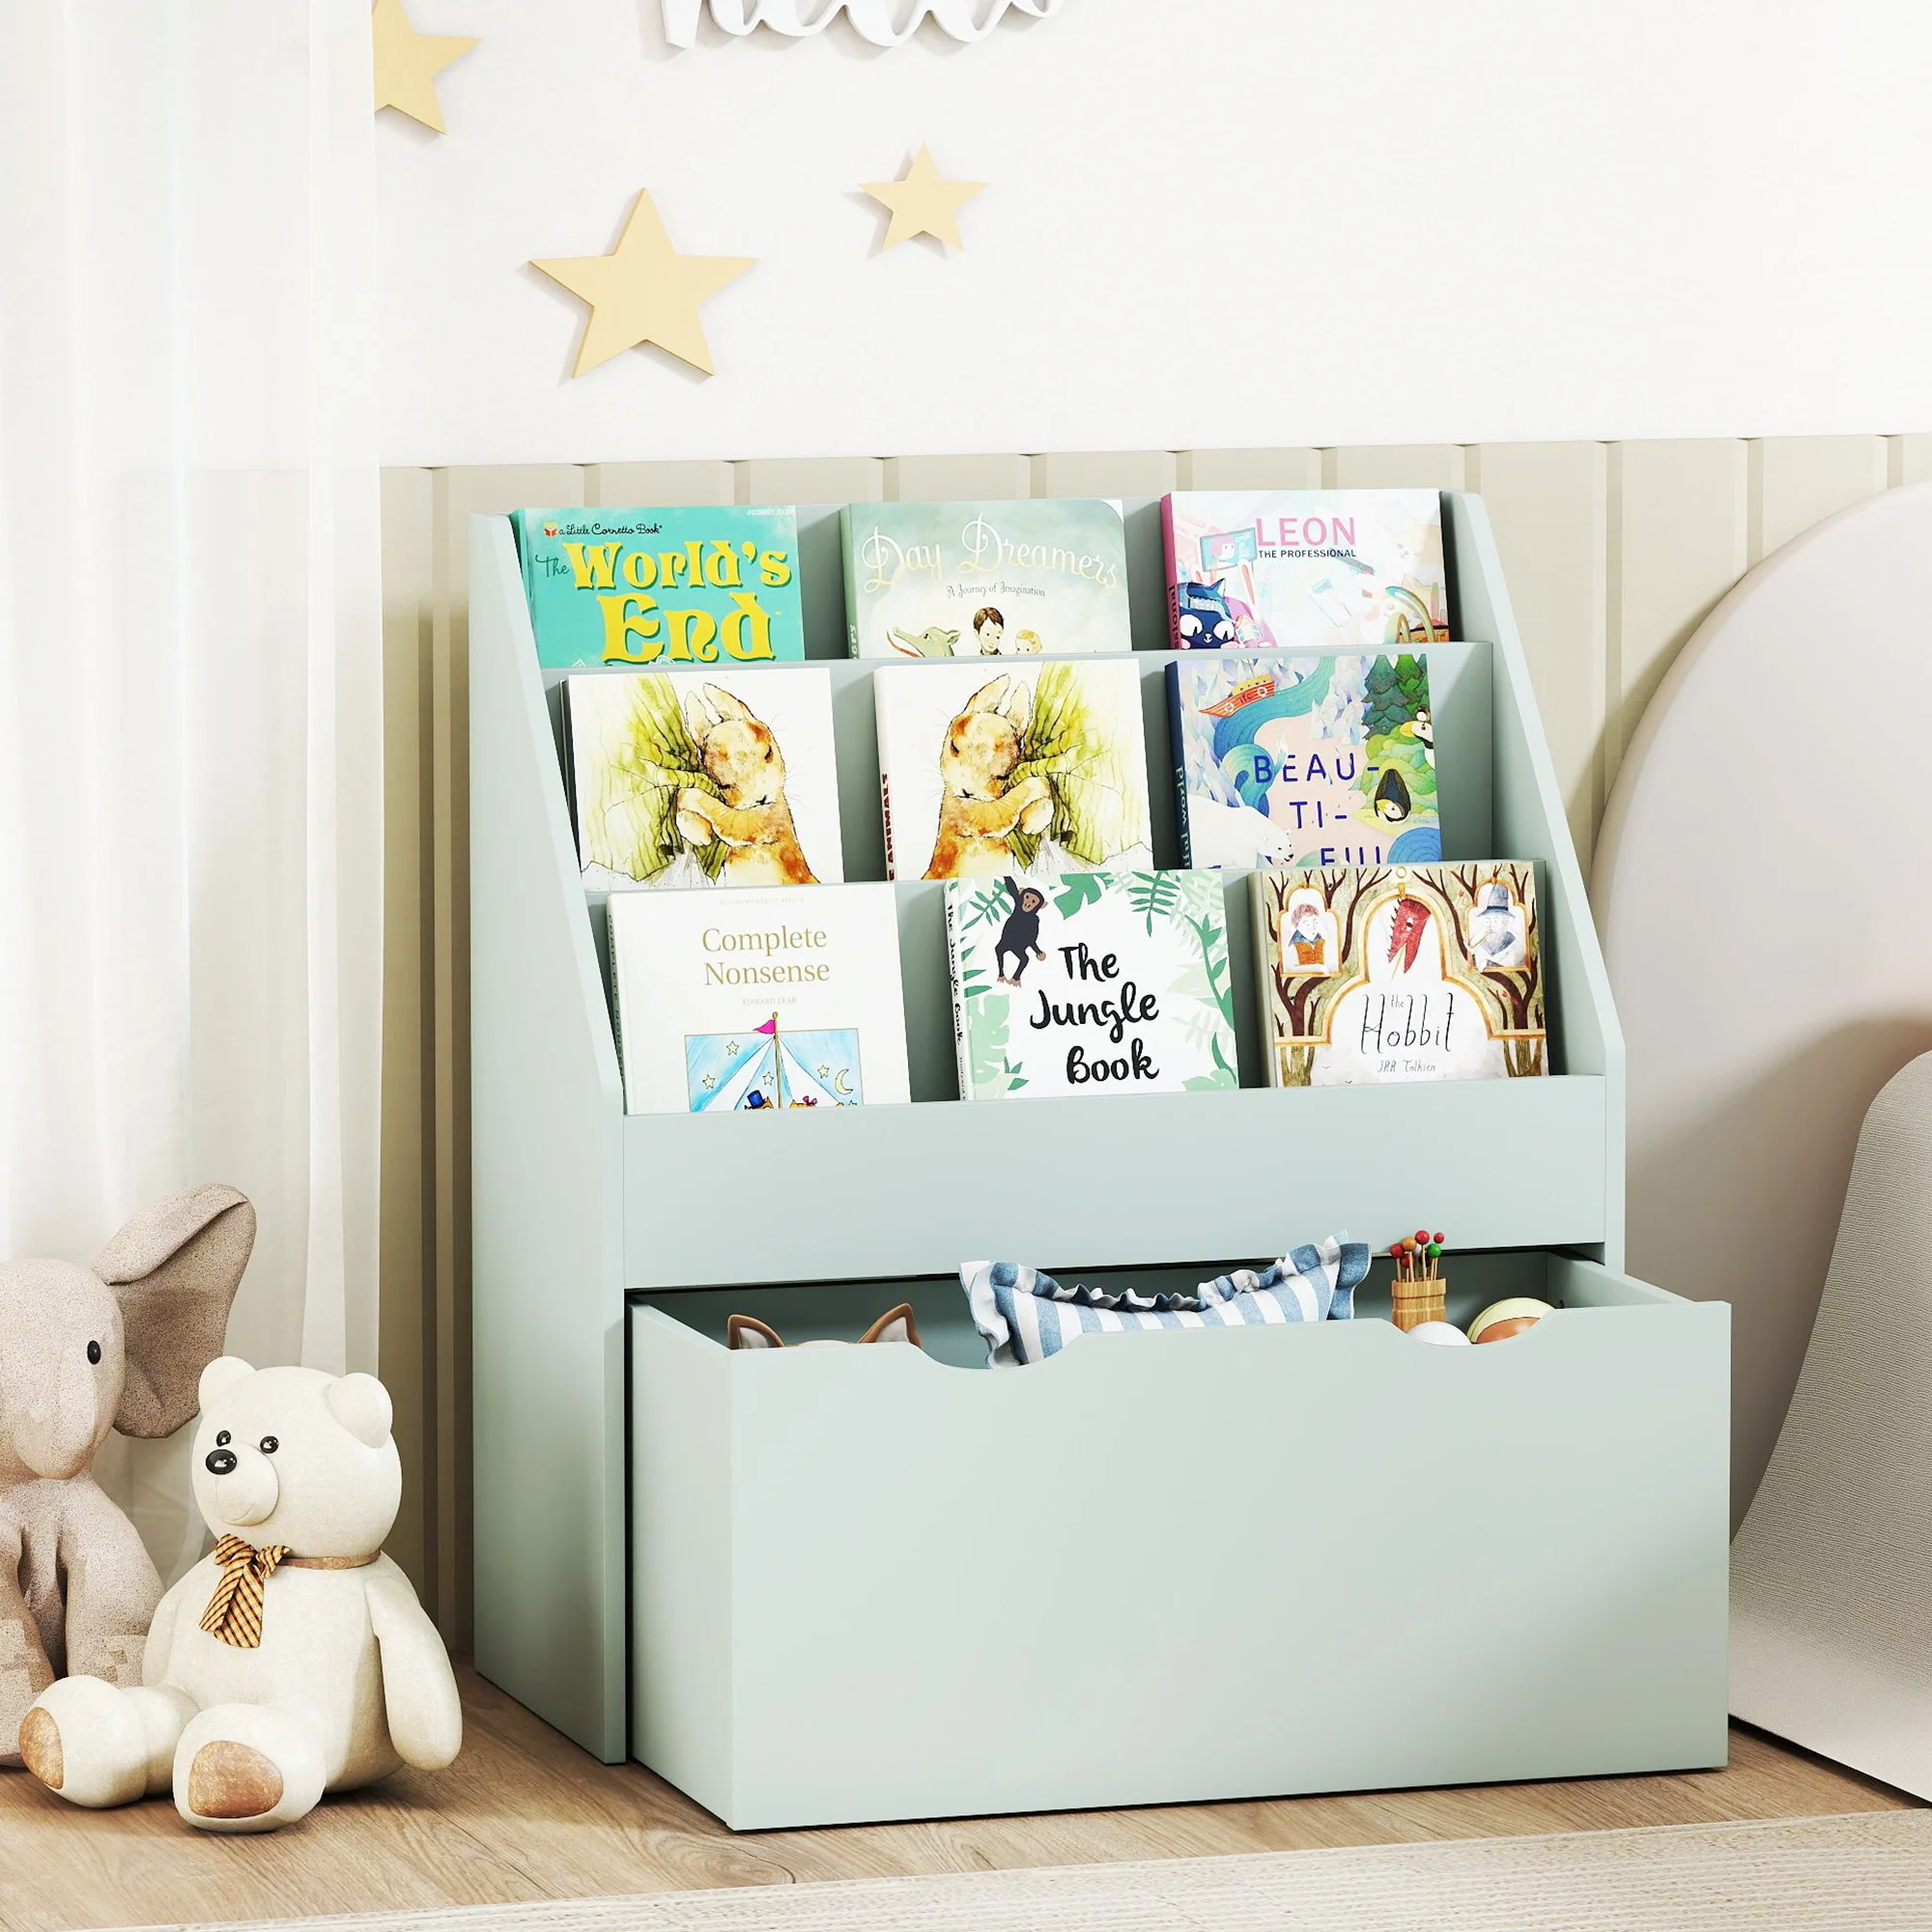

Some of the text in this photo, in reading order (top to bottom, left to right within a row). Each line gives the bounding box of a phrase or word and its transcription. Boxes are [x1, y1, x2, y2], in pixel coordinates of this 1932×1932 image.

[566, 524, 590, 535] Little
[591, 523, 635, 535] Cornetto
[1256, 517, 1356, 547] LEON
[535, 540, 792, 591] The World's
[861, 512, 1118, 593] Day Dreamers
[1258, 549, 1357, 558] THE PROFESSIONAL
[958, 583, 987, 598] Journey
[988, 582, 998, 593] of
[999, 581, 1046, 597] Imagination
[596, 592, 778, 664] End
[702, 924, 828, 957] Complete
[704, 960, 830, 987] Nonsense
[1058, 942, 1120, 981] The
[1030, 981, 1159, 1043] Jungle
[1391, 994, 1405, 1008] the
[1360, 992, 1455, 1054] Hobbit
[1403, 1059, 1436, 1073] Tolkien
